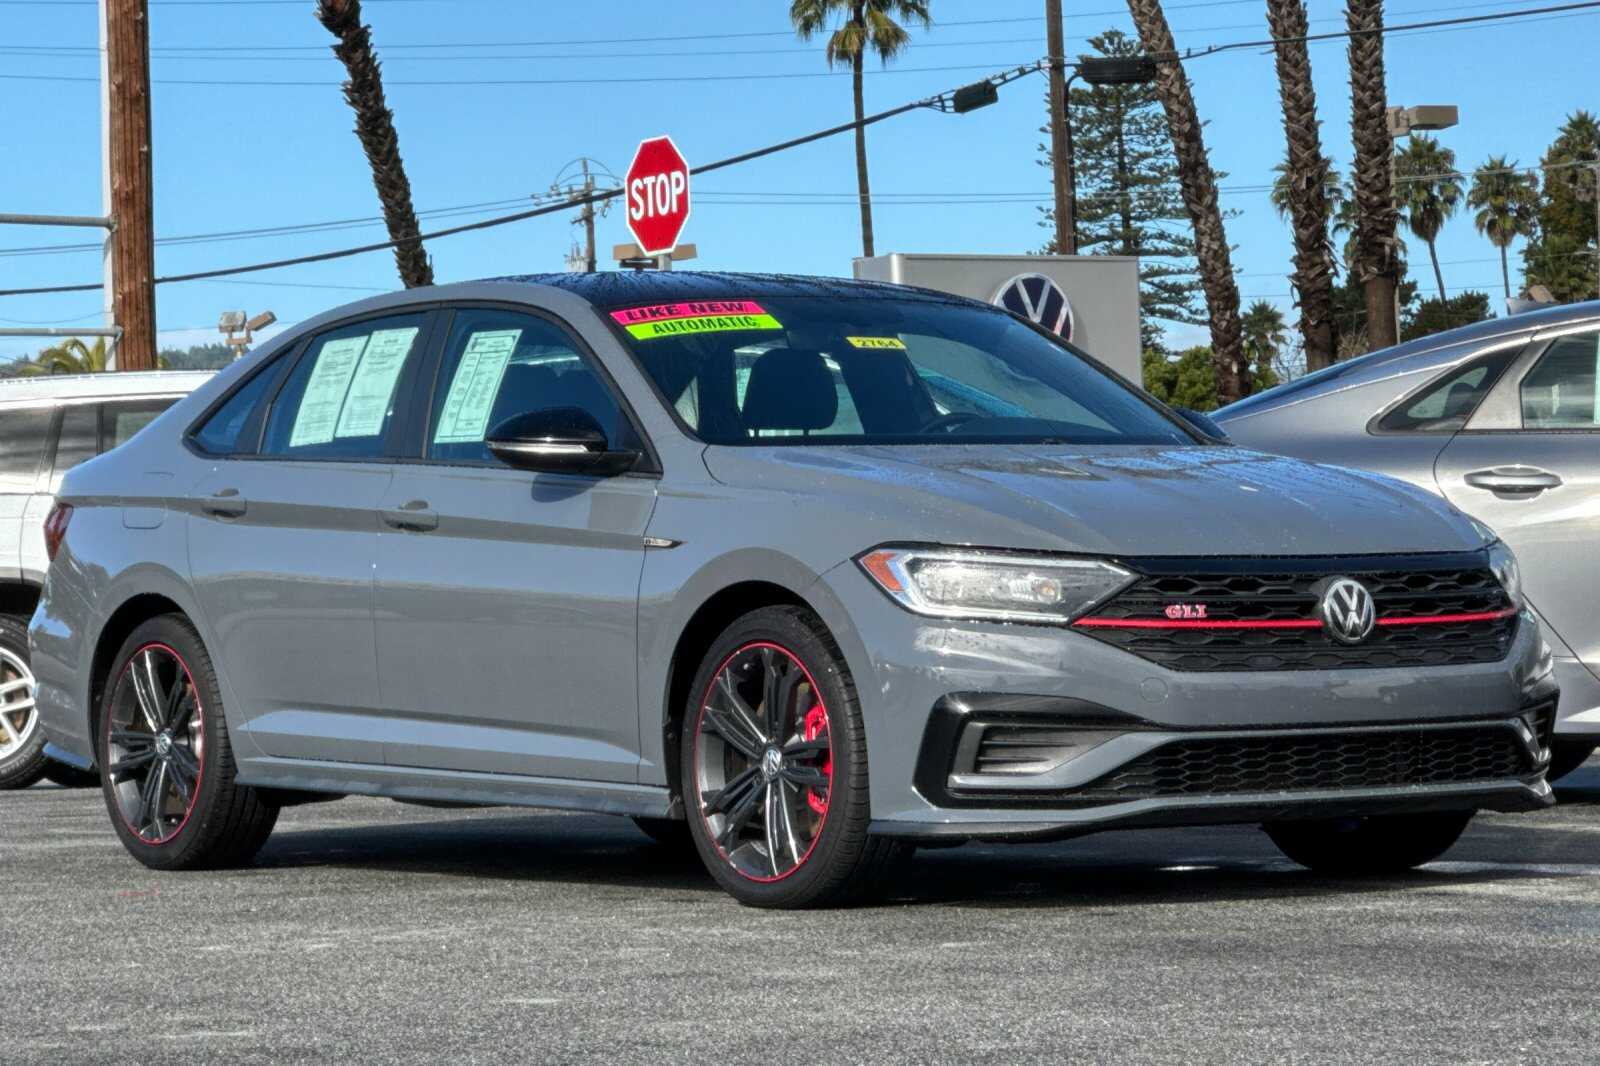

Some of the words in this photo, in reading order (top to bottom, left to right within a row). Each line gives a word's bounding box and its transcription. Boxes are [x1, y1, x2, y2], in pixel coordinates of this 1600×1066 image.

[630, 170, 685, 221] STOP
[626, 305, 680, 321] LIKE
[688, 302, 744, 315] NEW
[652, 316, 757, 334] AUTOMATIC
[1165, 604, 1208, 619] GLI
